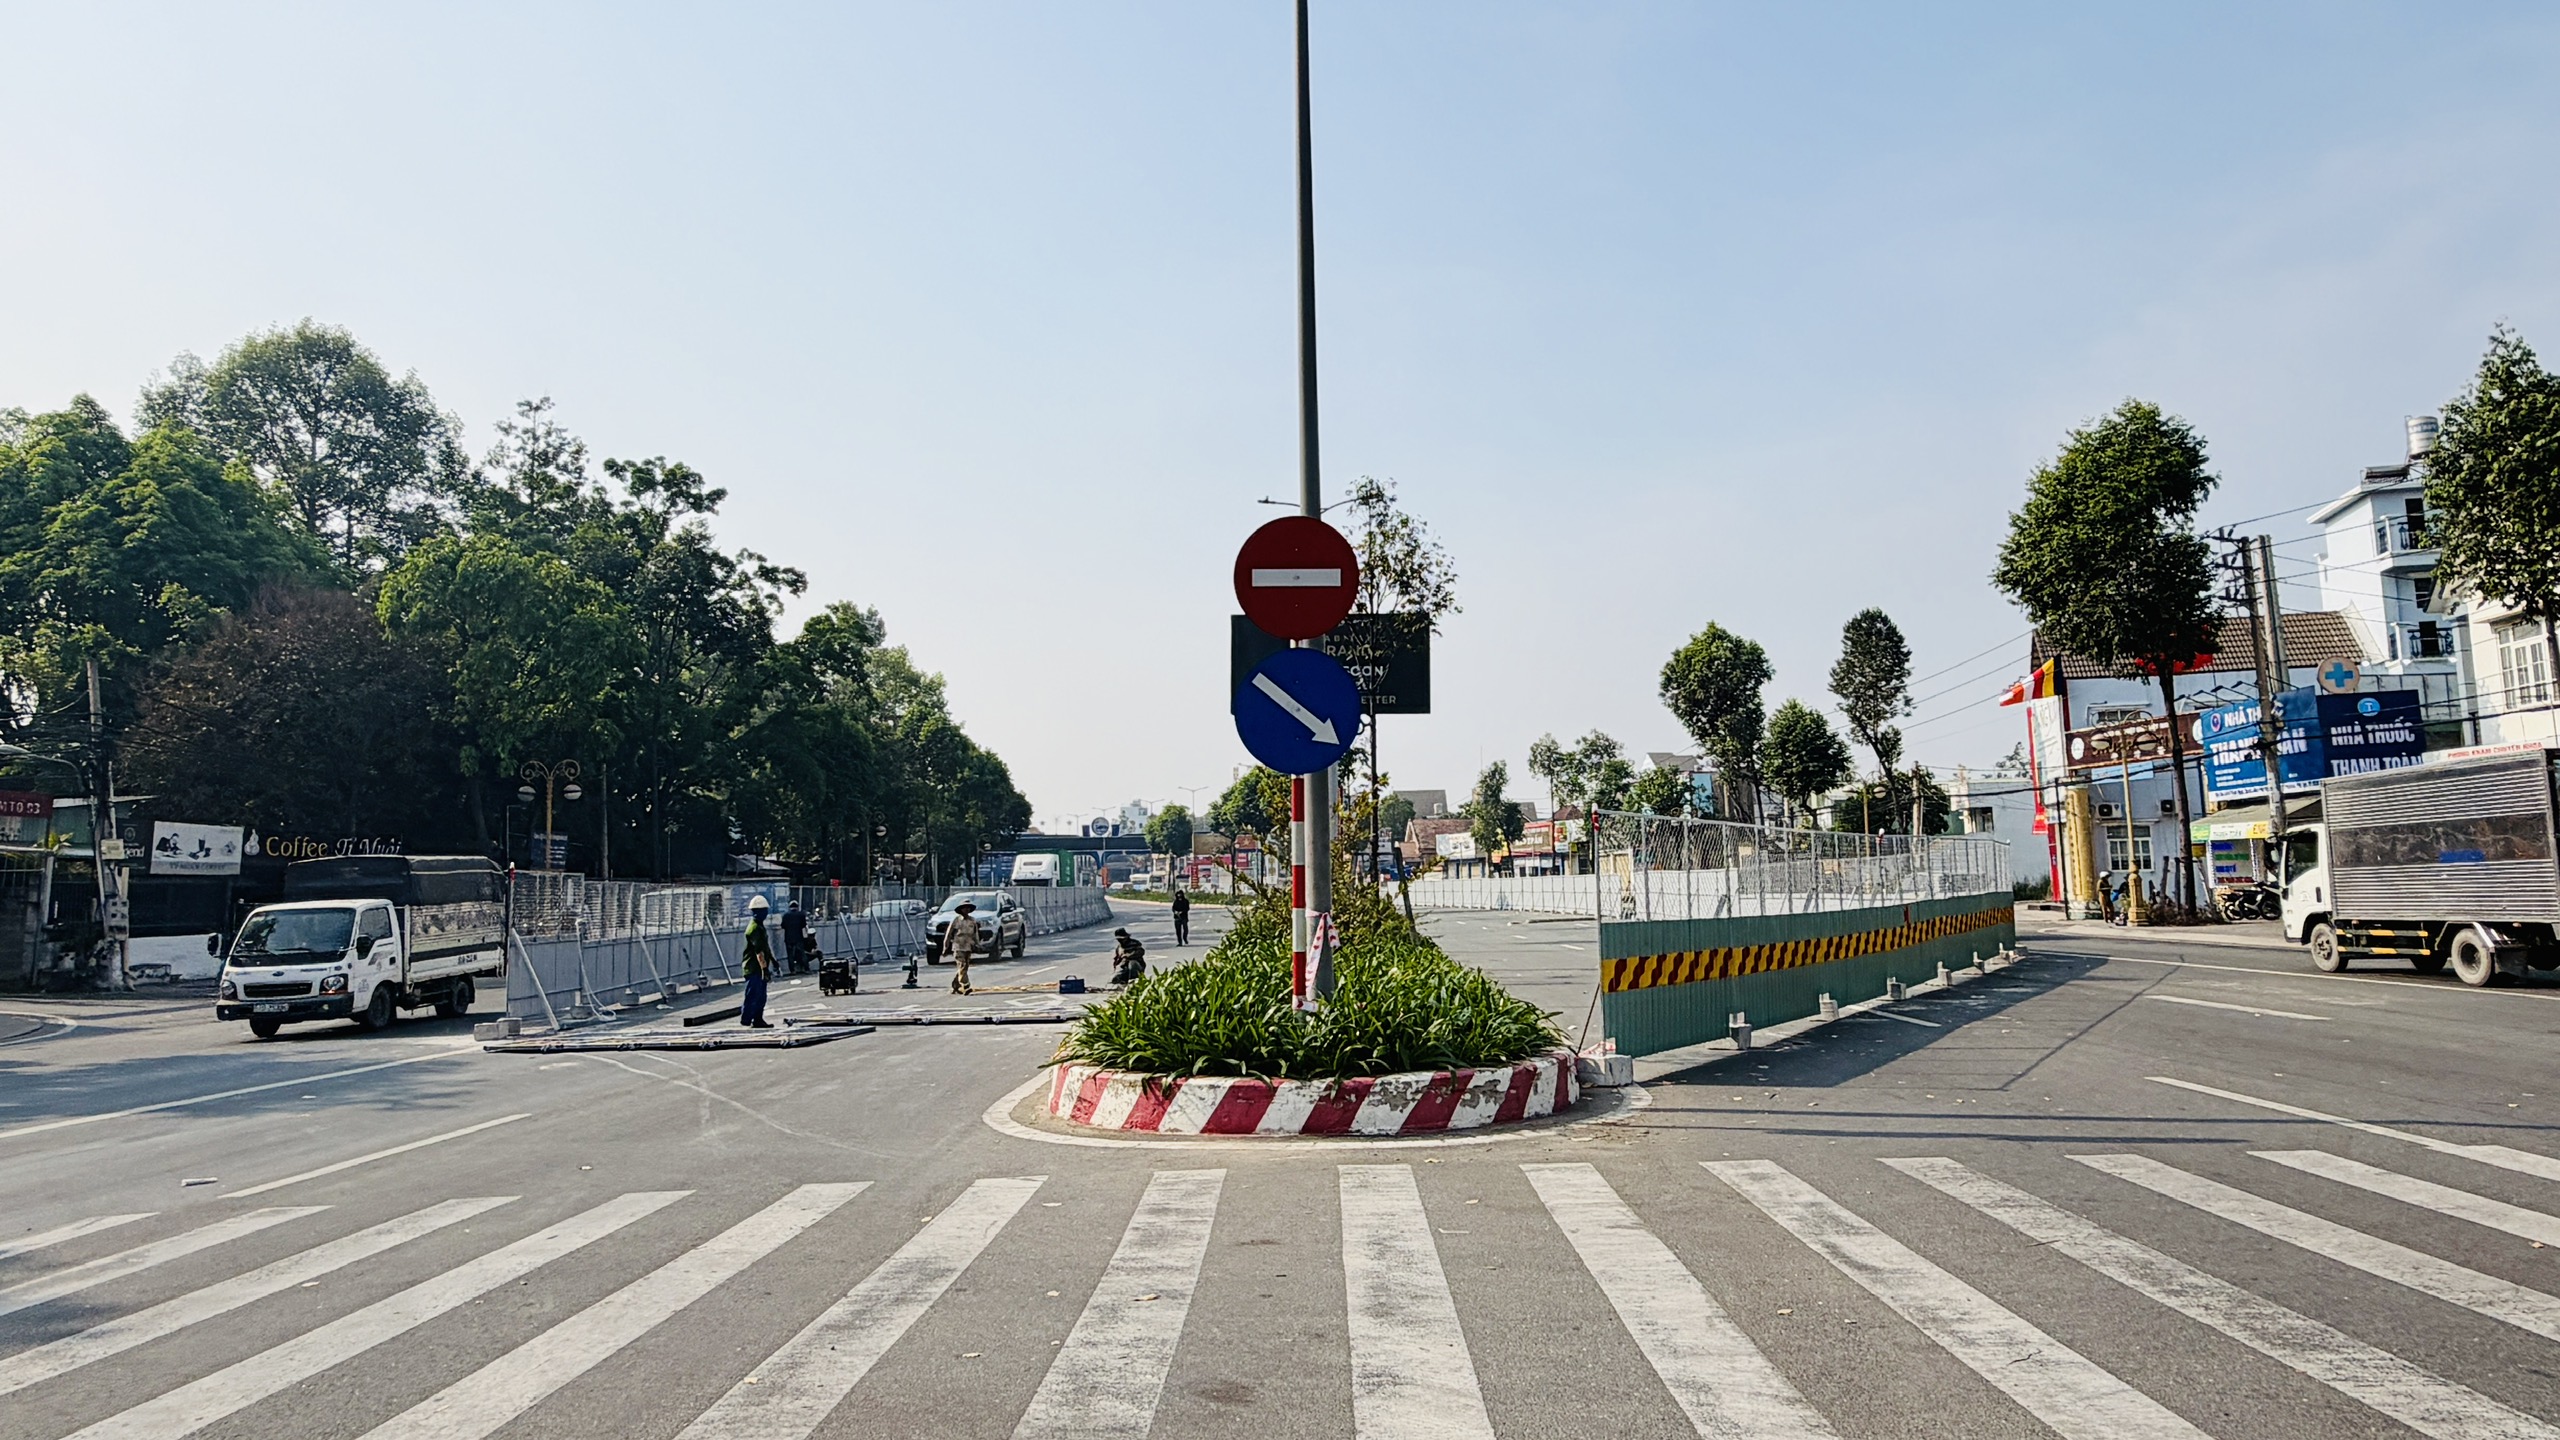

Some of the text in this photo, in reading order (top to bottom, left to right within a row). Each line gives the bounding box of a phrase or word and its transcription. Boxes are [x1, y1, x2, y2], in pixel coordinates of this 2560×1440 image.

[2331, 716, 2415, 746] NHÀ THUỐC
[2330, 757, 2381, 777] THANH
[266, 836, 328, 857] Coffee
